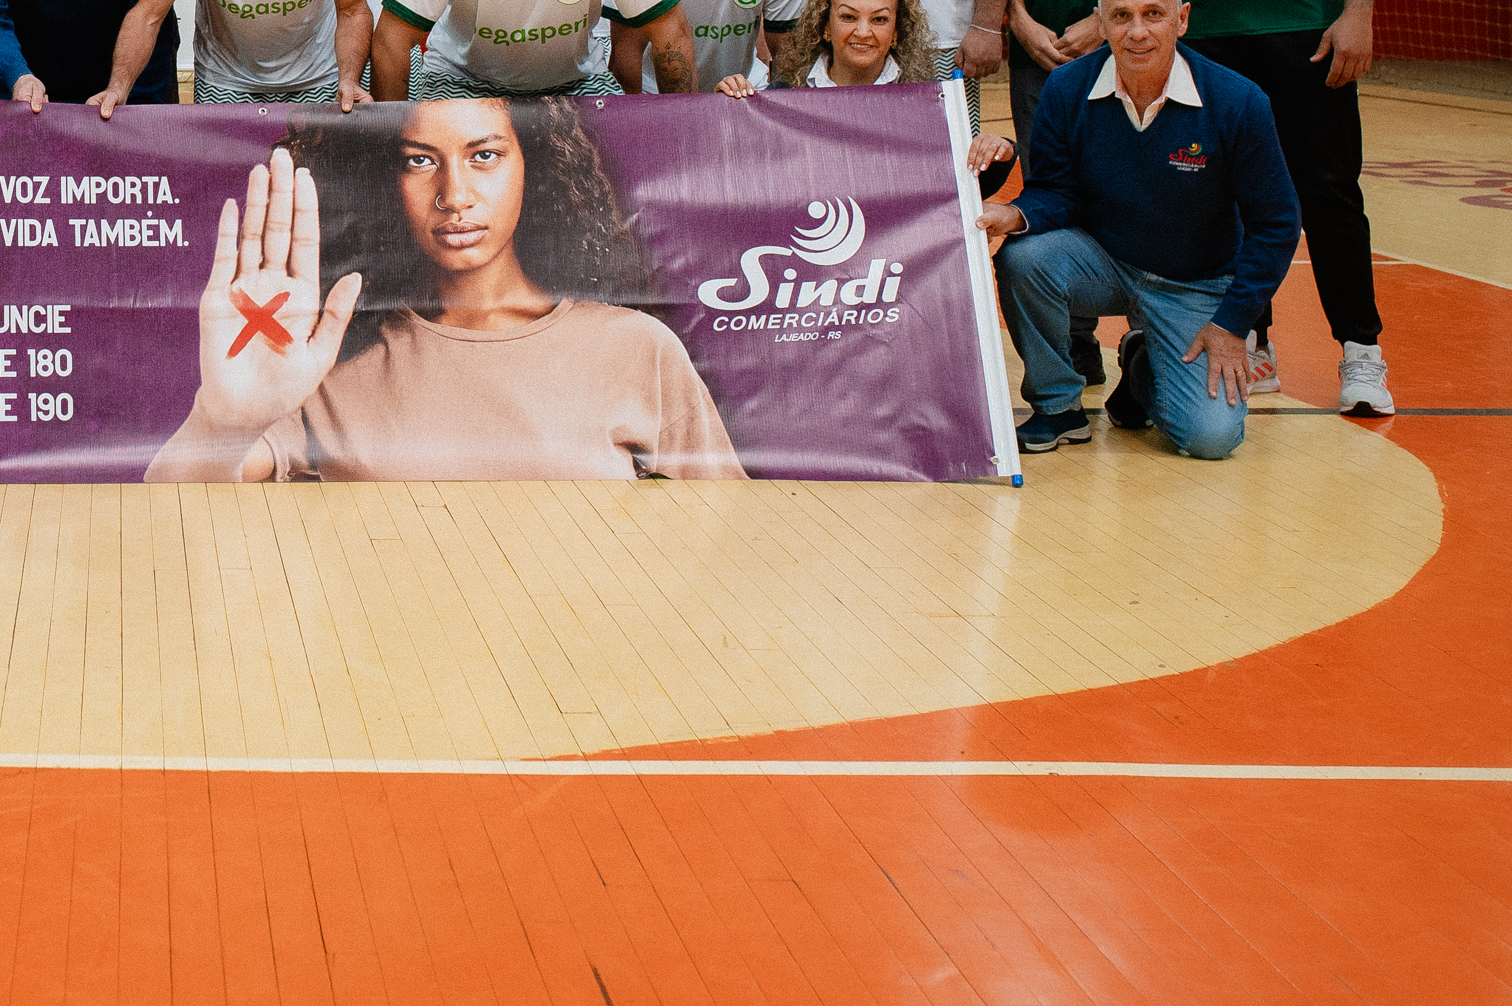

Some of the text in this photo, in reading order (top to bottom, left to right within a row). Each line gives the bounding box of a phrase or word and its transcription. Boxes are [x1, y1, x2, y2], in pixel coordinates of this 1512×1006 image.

[474, 14, 588, 47] egasperi
[694, 16, 760, 43] asperi
[60, 176, 180, 205] IMPORTA.
[0, 218, 59, 247] VIDA
[68, 210, 190, 247] TAMBÉM.
[697, 245, 904, 311] Sindi
[712, 308, 900, 332] COMERCIÁRIOS
[774, 332, 819, 343] LAJEADO
[827, 330, 842, 340] RS
[27, 348, 73, 378] 180
[28, 392, 74, 422] 190
